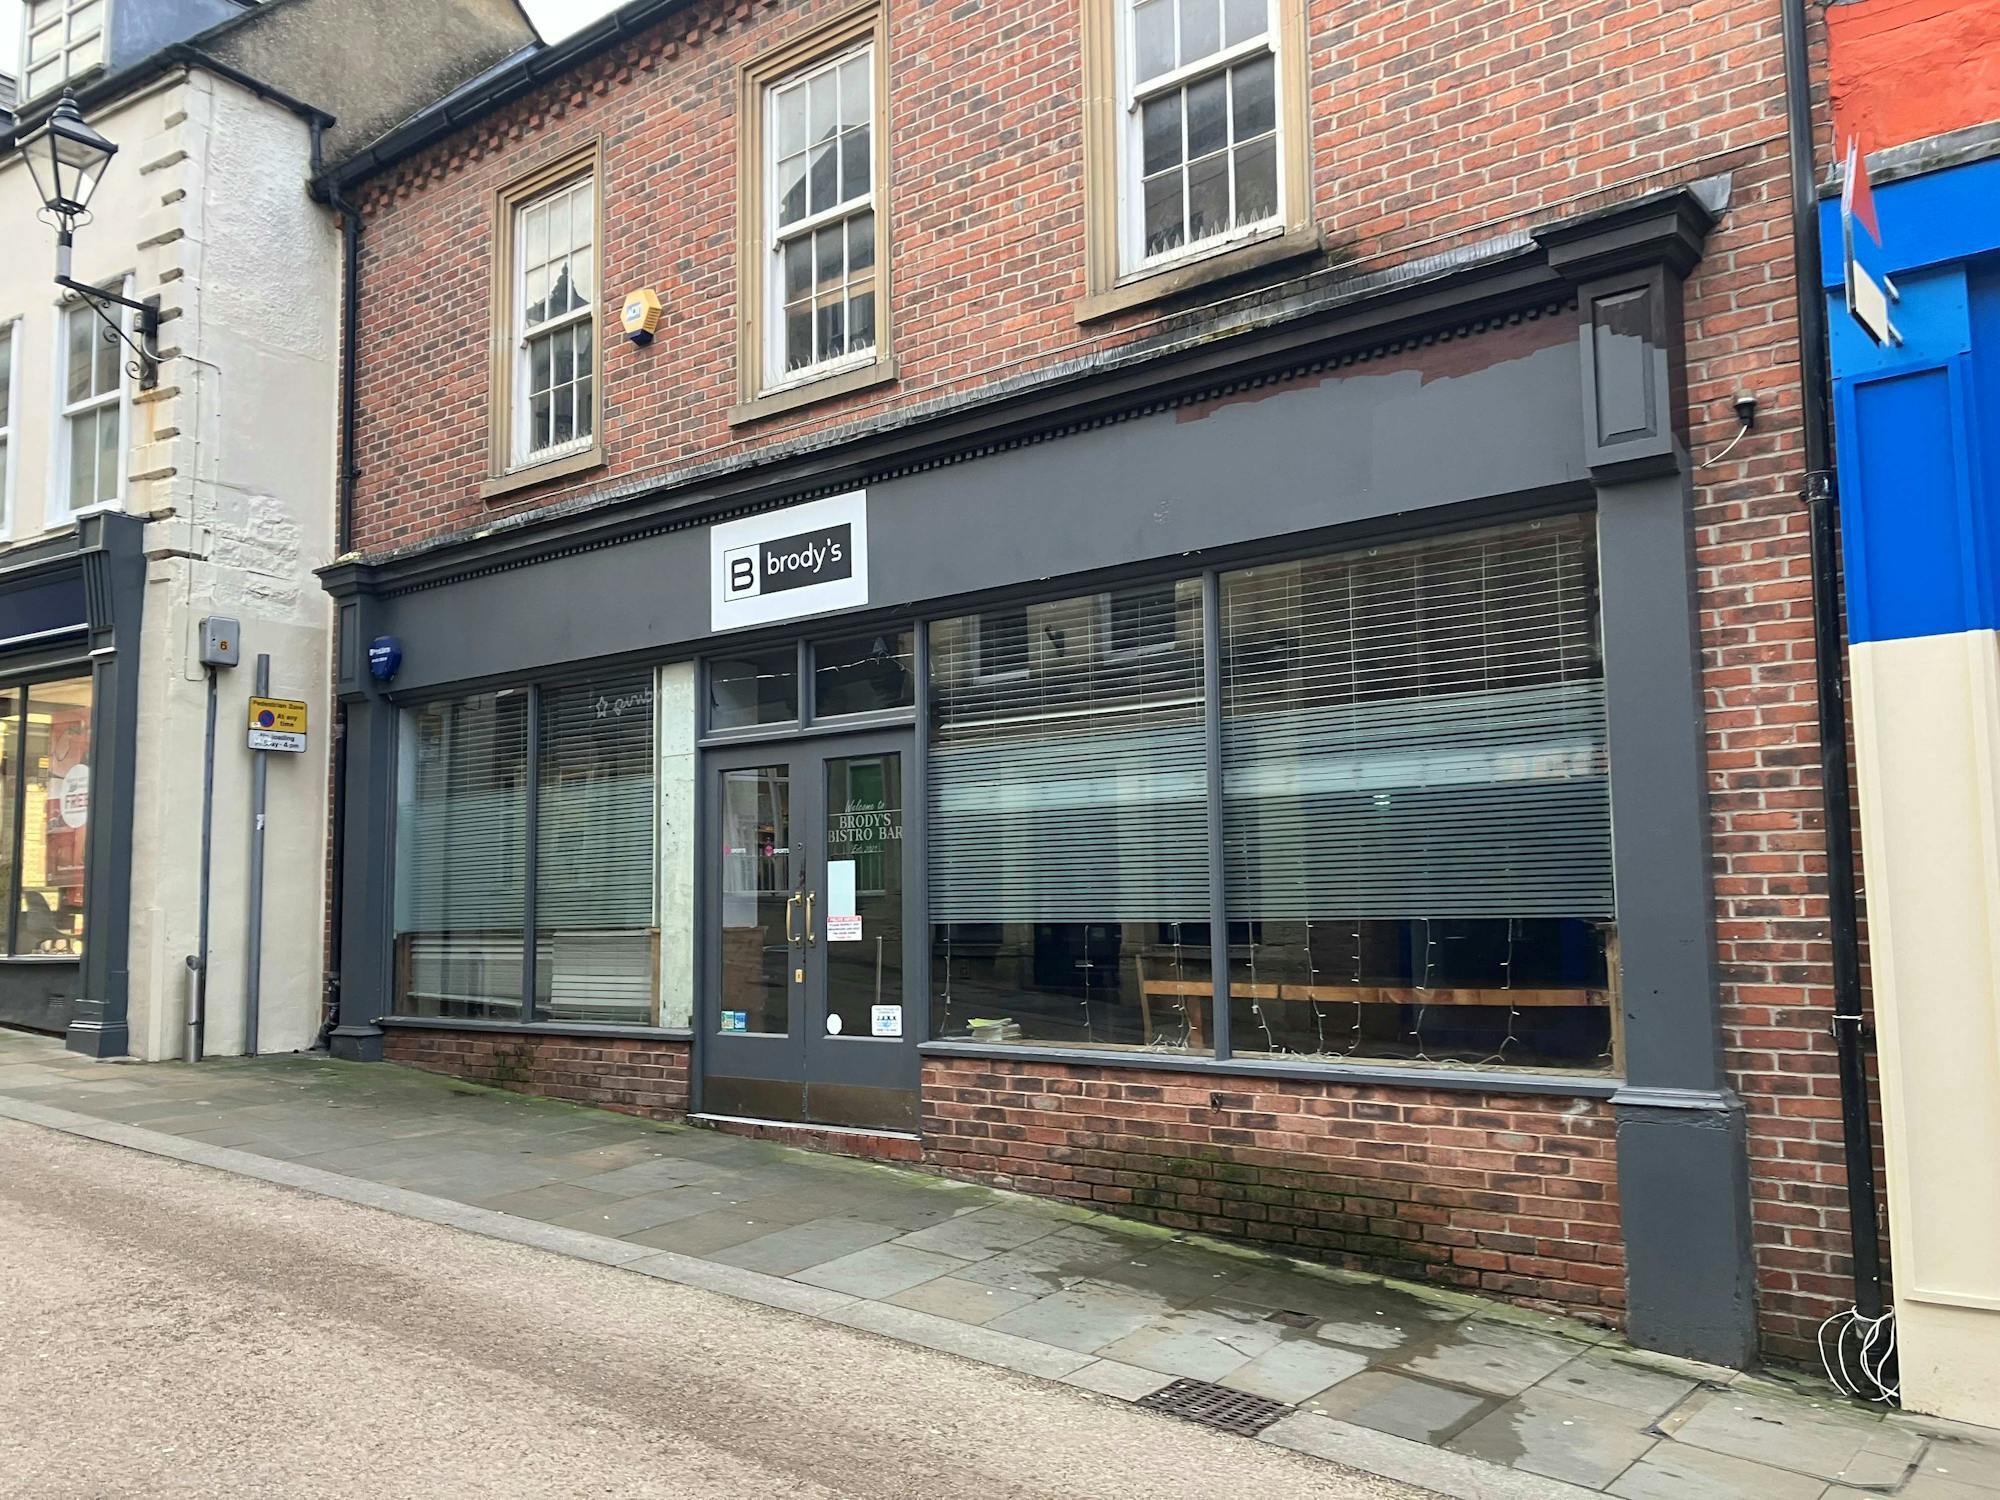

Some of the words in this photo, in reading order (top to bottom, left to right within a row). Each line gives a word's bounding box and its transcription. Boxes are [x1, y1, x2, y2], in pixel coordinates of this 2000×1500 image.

[767, 538, 843, 575] brody's
[731, 557, 754, 592] B
[839, 812, 892, 829] BRODY'S
[827, 827, 873, 843] BISTRO
[878, 825, 904, 840] BAR
